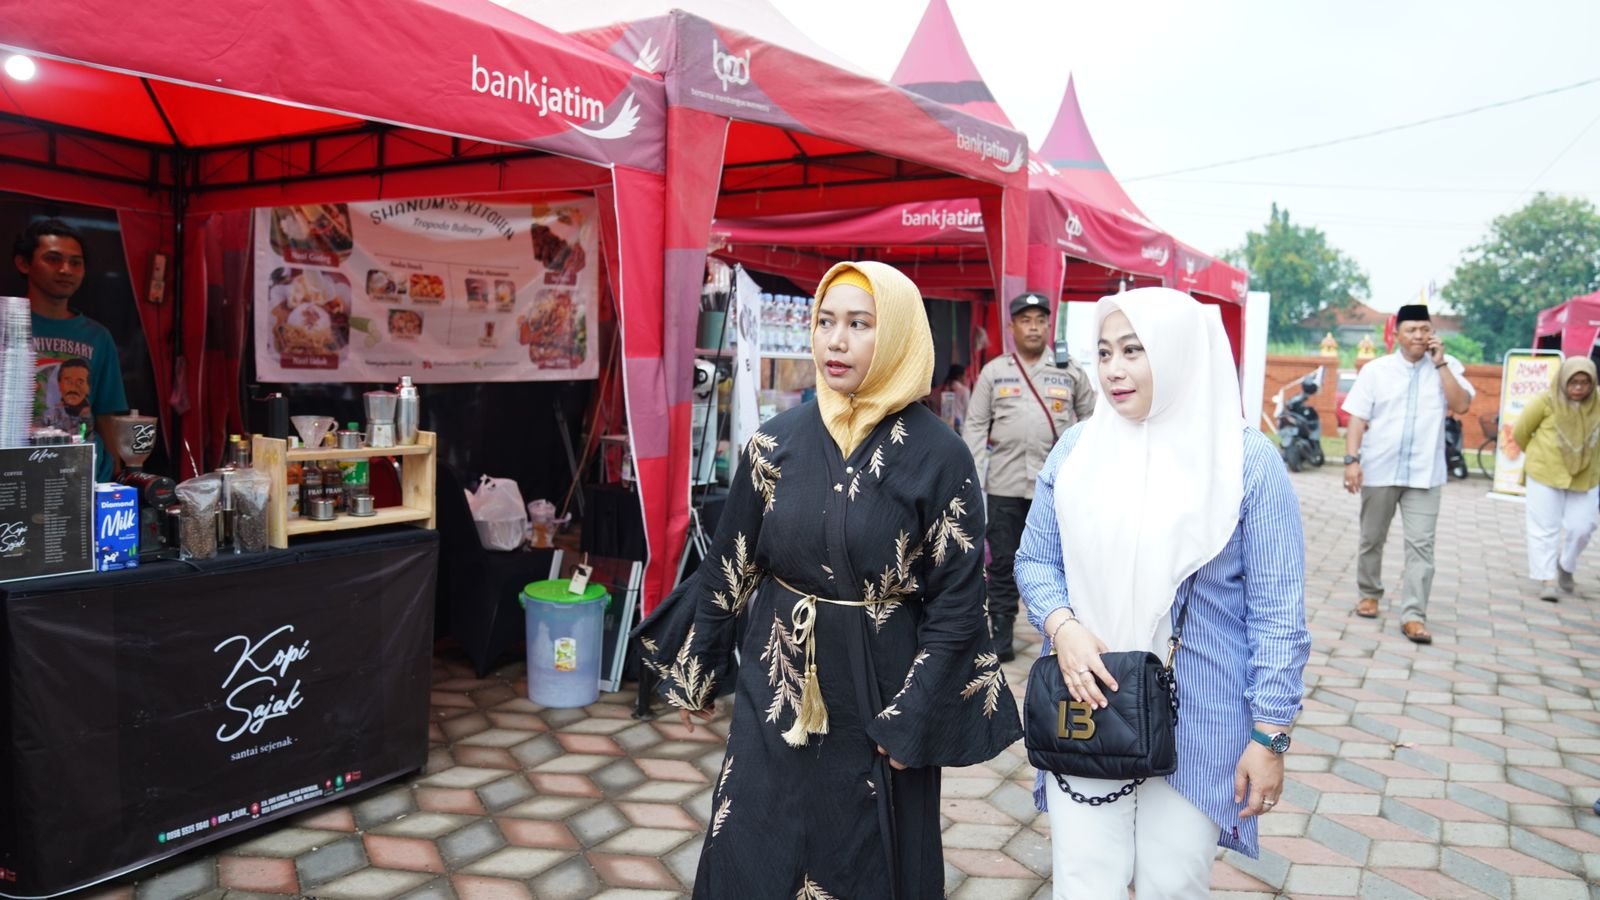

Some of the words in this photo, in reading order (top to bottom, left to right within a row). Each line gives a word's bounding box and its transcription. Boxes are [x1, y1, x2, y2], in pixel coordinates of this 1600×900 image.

[471, 54, 604, 123] bankjatim
[956, 126, 1009, 163] bankjatim
[101, 499, 134, 509] Diamond
[101, 508, 136, 540] Milk
[213, 624, 310, 689] Kopi
[216, 676, 304, 742] Sajak
[230, 744, 259, 761] santai
[259, 735, 293, 754] sejenak
